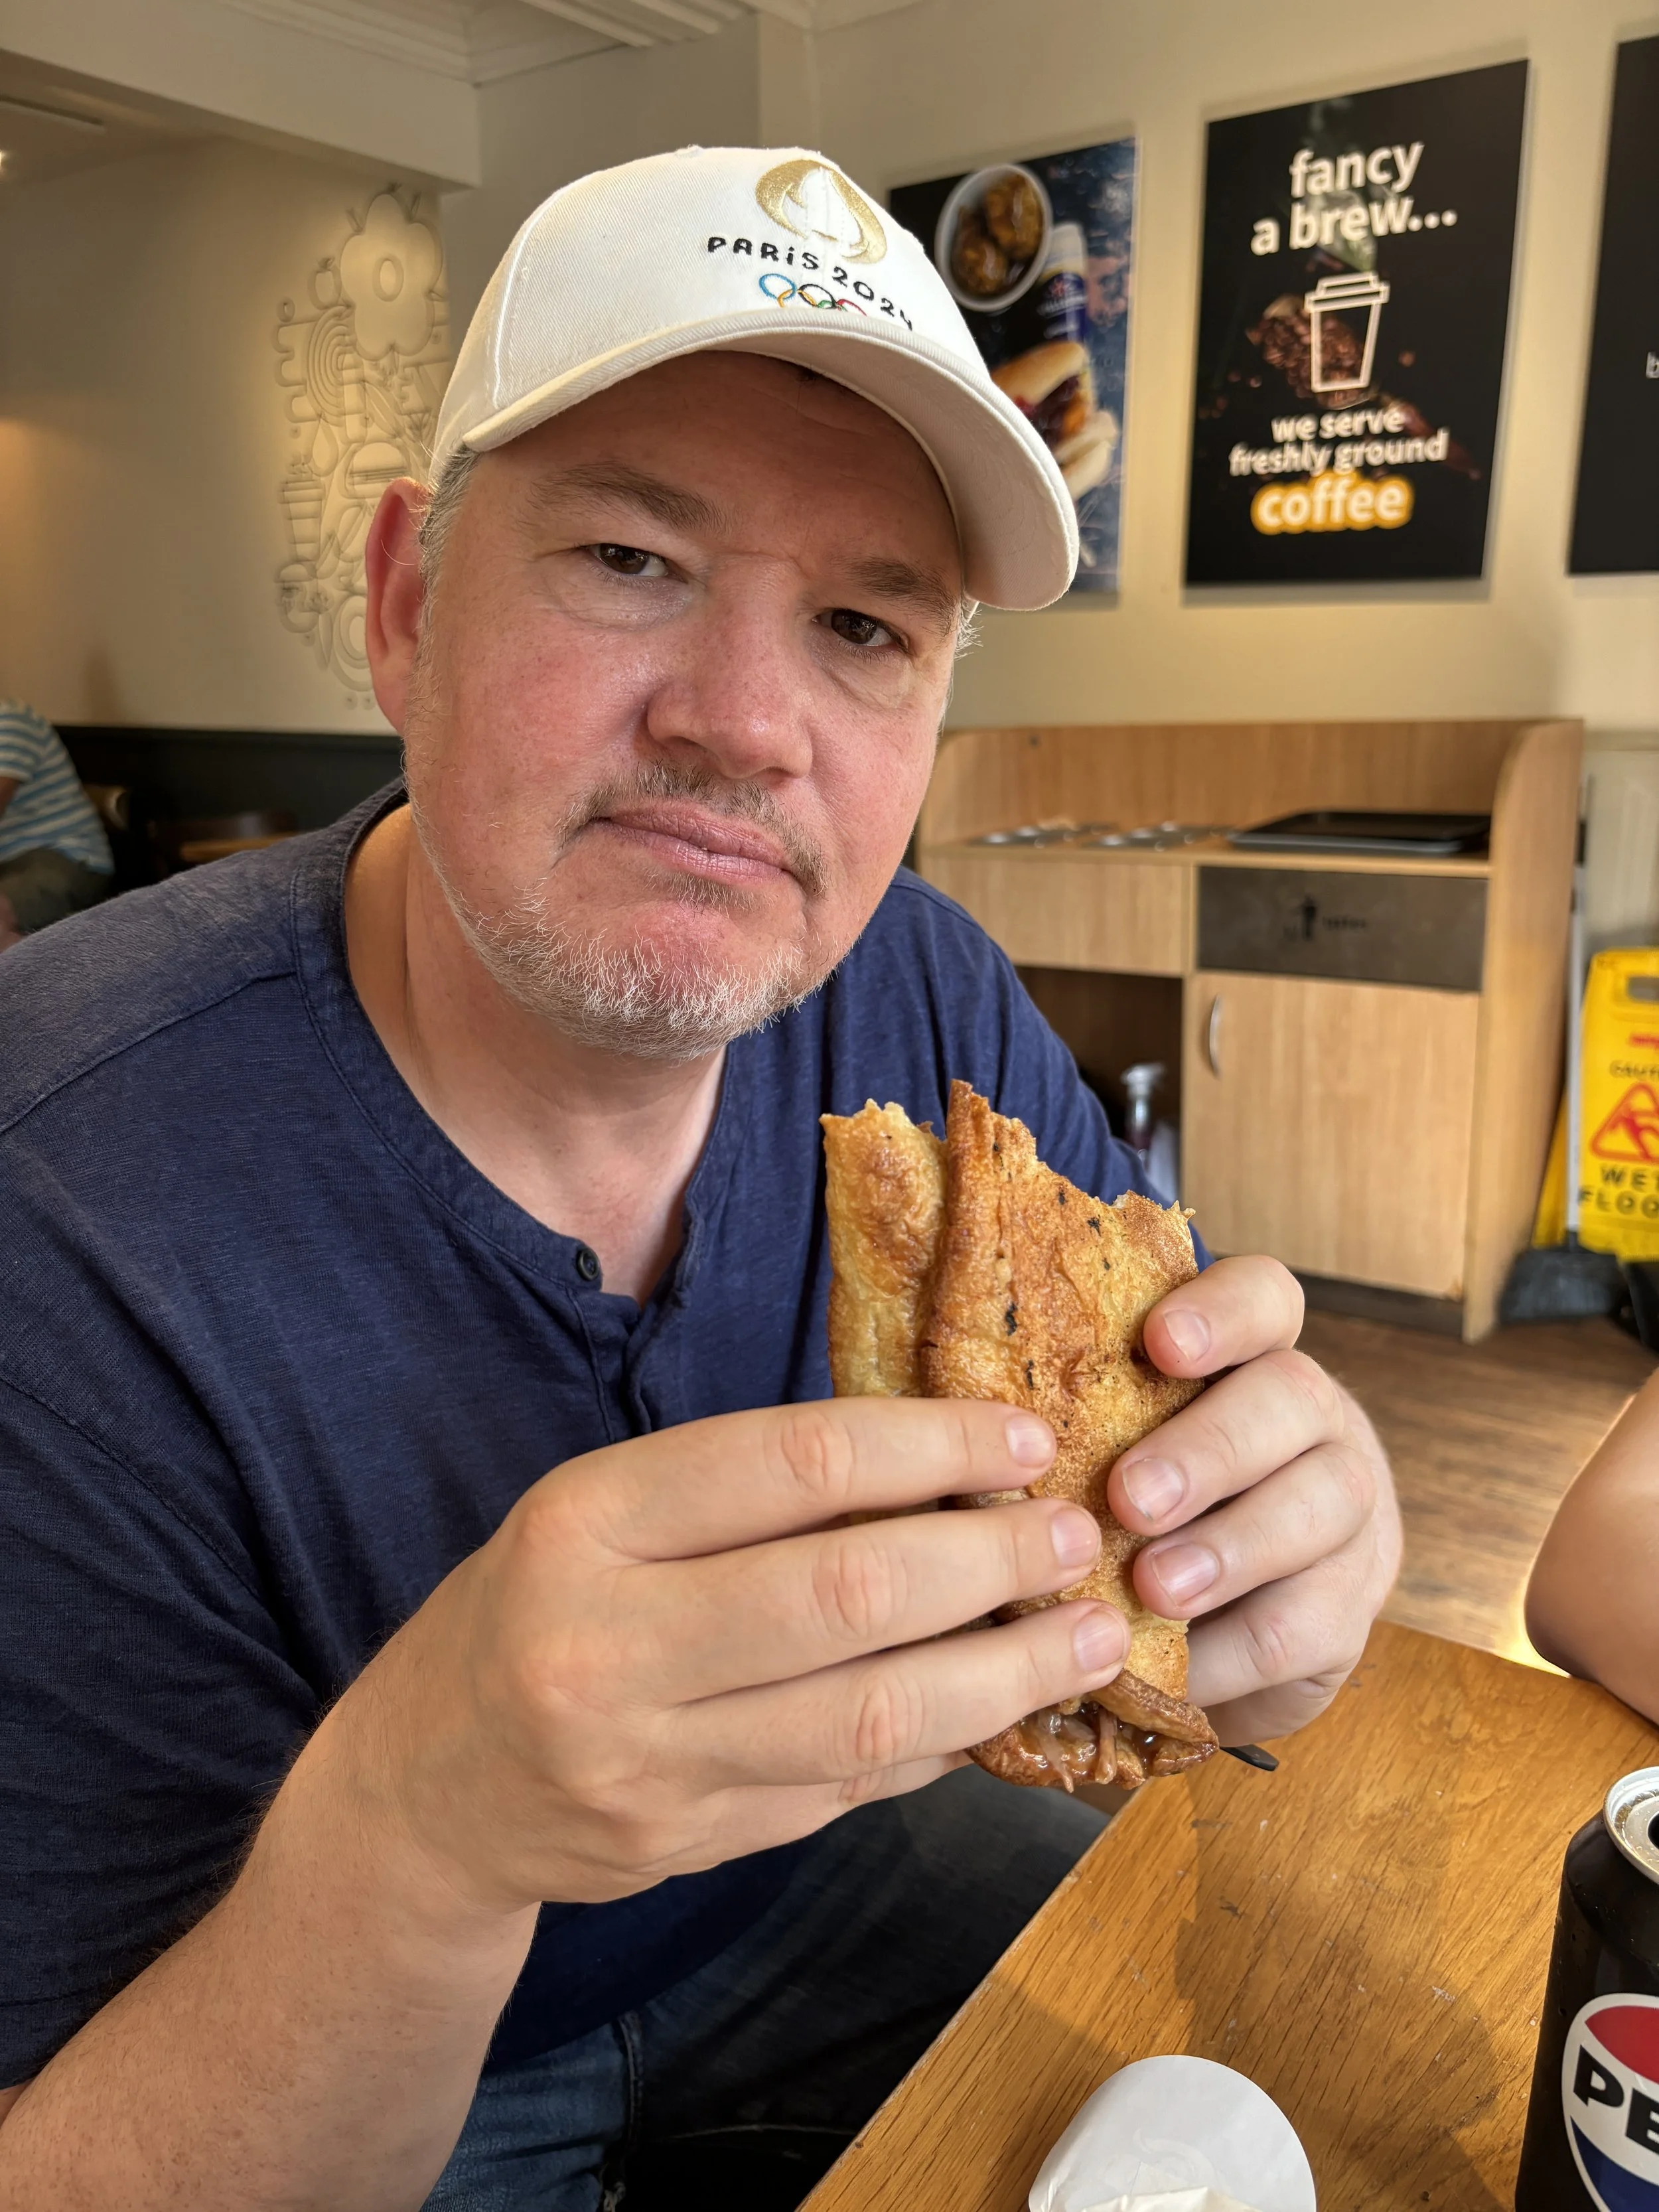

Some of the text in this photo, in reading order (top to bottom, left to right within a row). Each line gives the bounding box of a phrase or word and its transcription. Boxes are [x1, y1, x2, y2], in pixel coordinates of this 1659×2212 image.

[1289, 141, 1425, 198] fancy
[1250, 196, 1458, 256] a brew...
[832, 266, 912, 331] 2024
[1228, 427, 1451, 477] freshly ground
[1271, 406, 1406, 443] we serve
[1256, 475, 1407, 528] coffee
